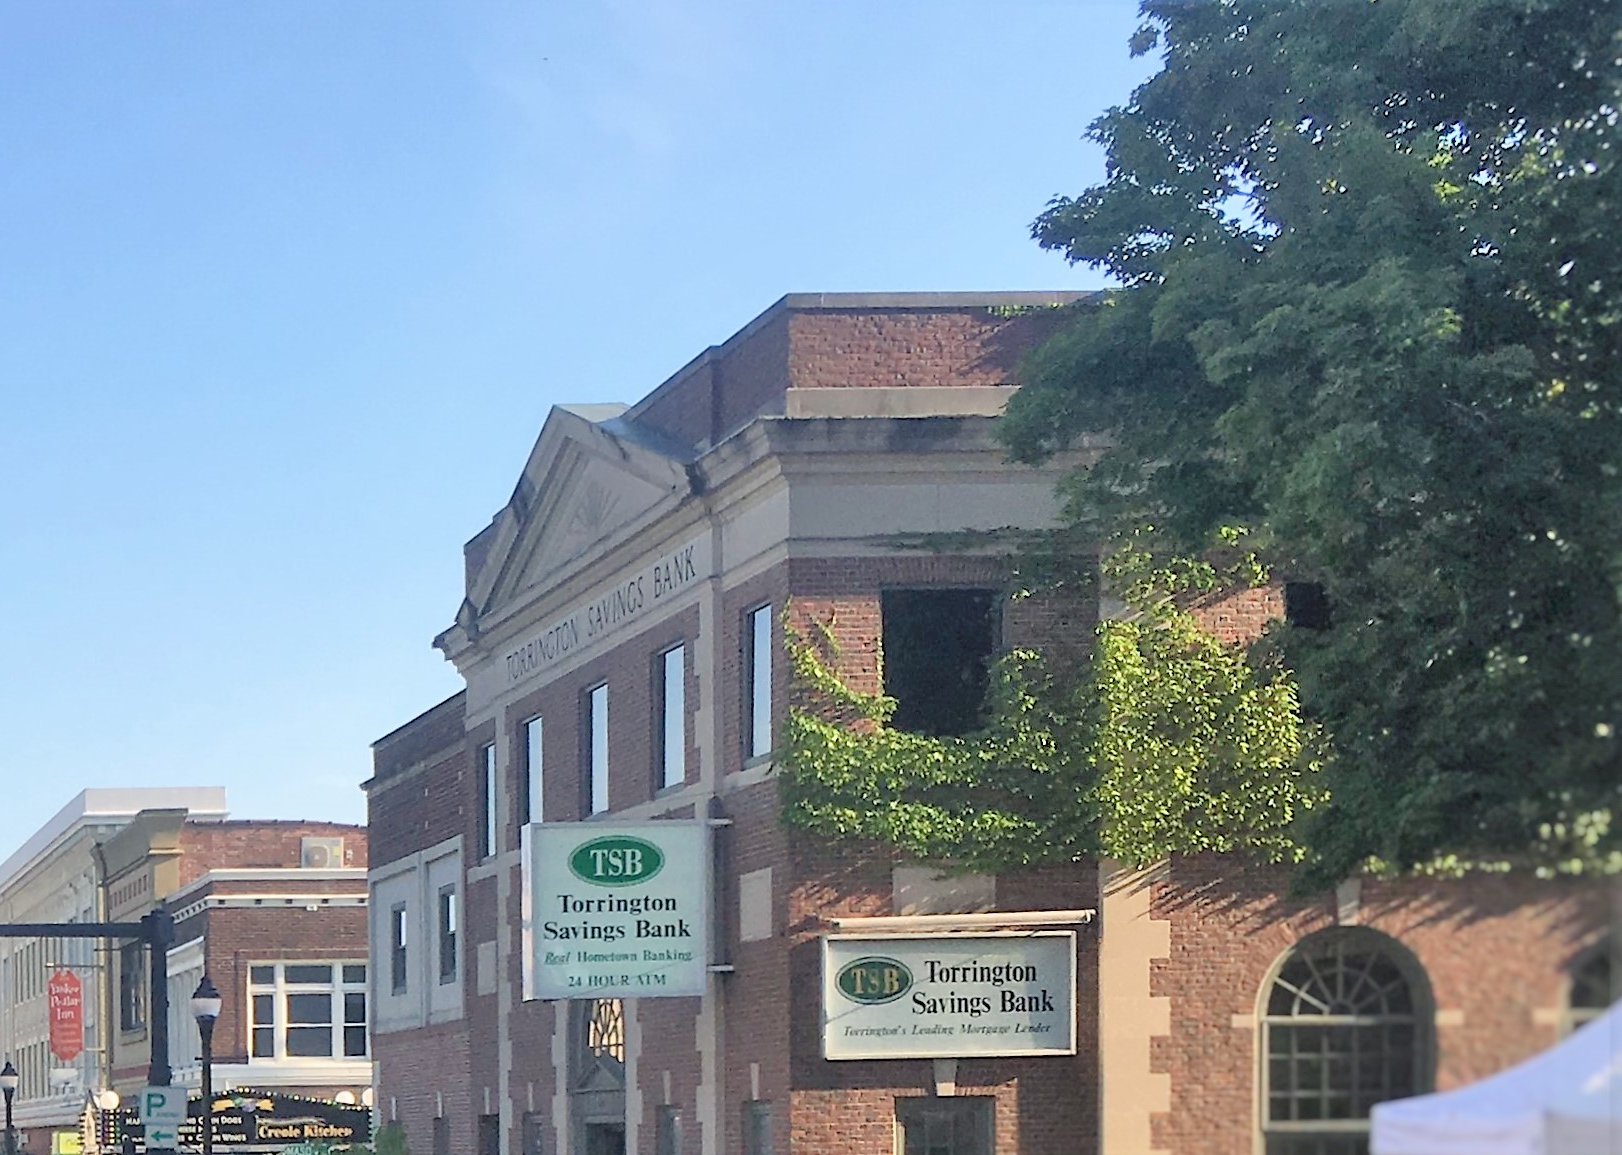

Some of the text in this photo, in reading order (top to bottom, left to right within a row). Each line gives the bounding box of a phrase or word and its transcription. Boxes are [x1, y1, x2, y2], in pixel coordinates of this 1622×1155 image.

[506, 545, 696, 683] TORRINGTON SAVINGS BANK
[590, 849, 643, 877] TSB
[557, 894, 677, 915] Torrington
[543, 919, 691, 942] Savings Bank
[578, 951, 637, 963] Hometown
[643, 949, 693, 962] Banking
[568, 976, 582, 987] 24
[588, 975, 631, 987] HOUR
[851, 960, 1038, 994] TSB Torrington
[911, 990, 1054, 1017] Savings Bank
[147, 1093, 166, 1117] P
[259, 1124, 354, 1138] Creole Kitchen
